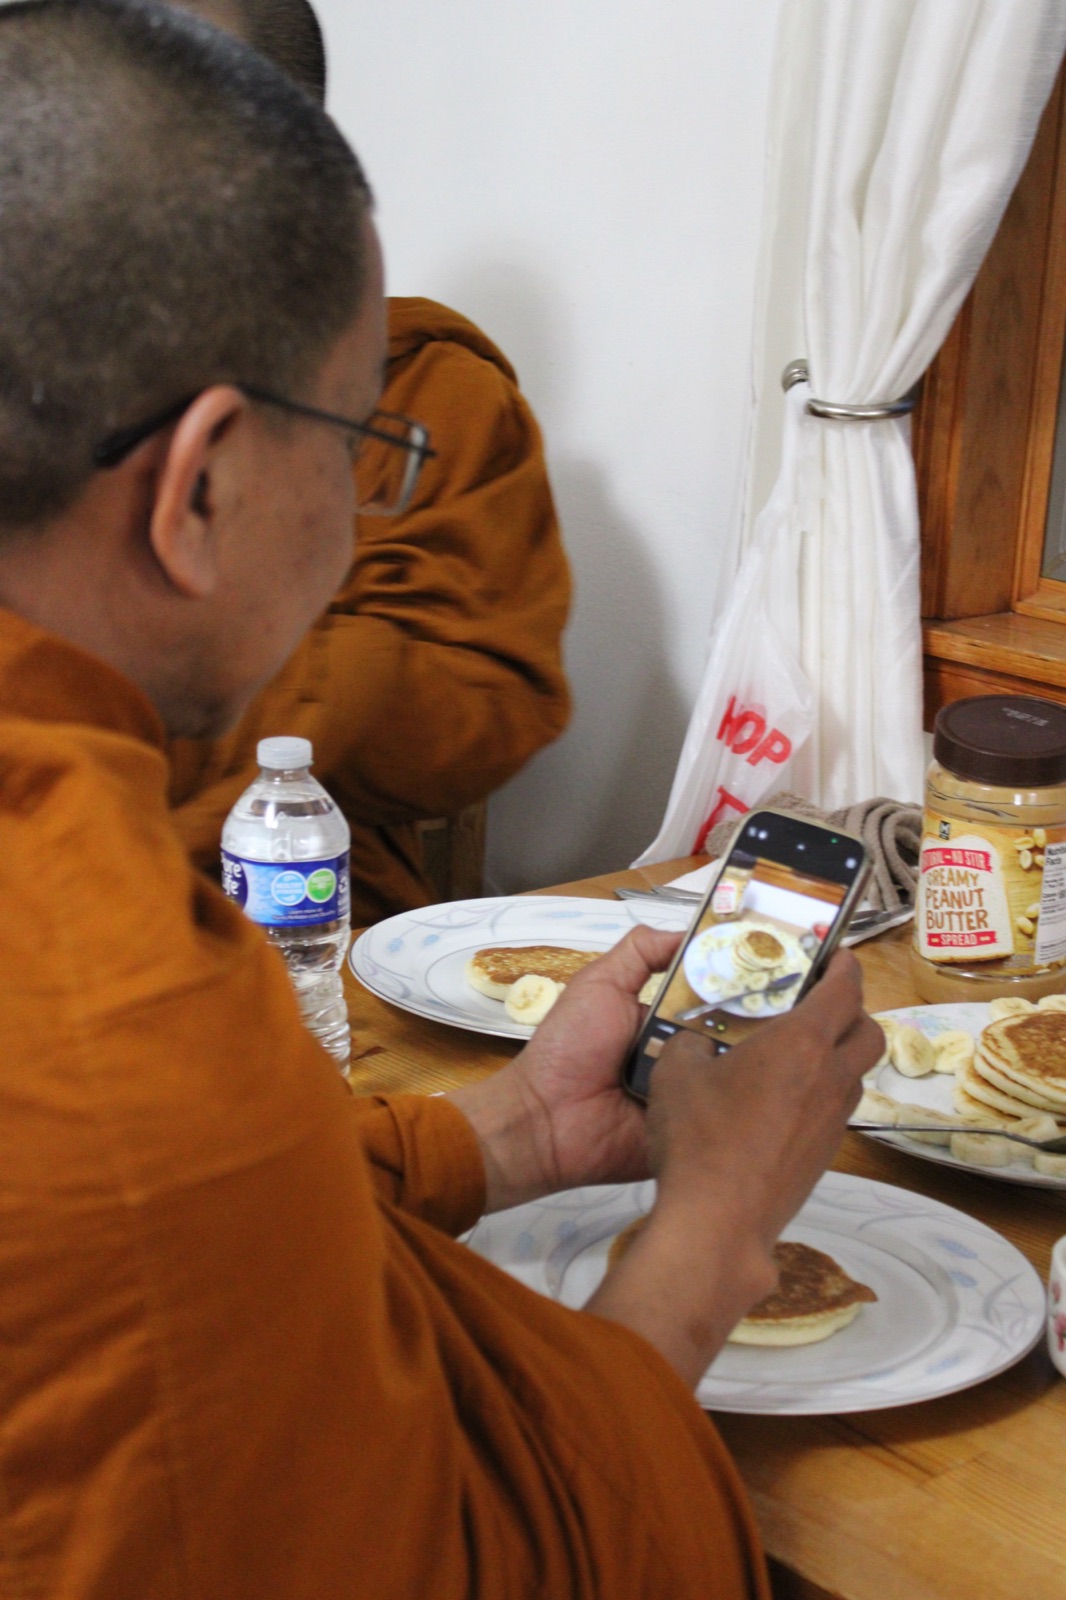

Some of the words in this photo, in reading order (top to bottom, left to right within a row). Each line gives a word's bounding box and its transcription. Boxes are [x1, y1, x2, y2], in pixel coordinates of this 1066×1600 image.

[927, 868, 979, 887] CREAMY
[926, 888, 984, 910] PEANUT
[927, 909, 989, 931] BUTTER
[940, 933, 978, 946] SPREAD
